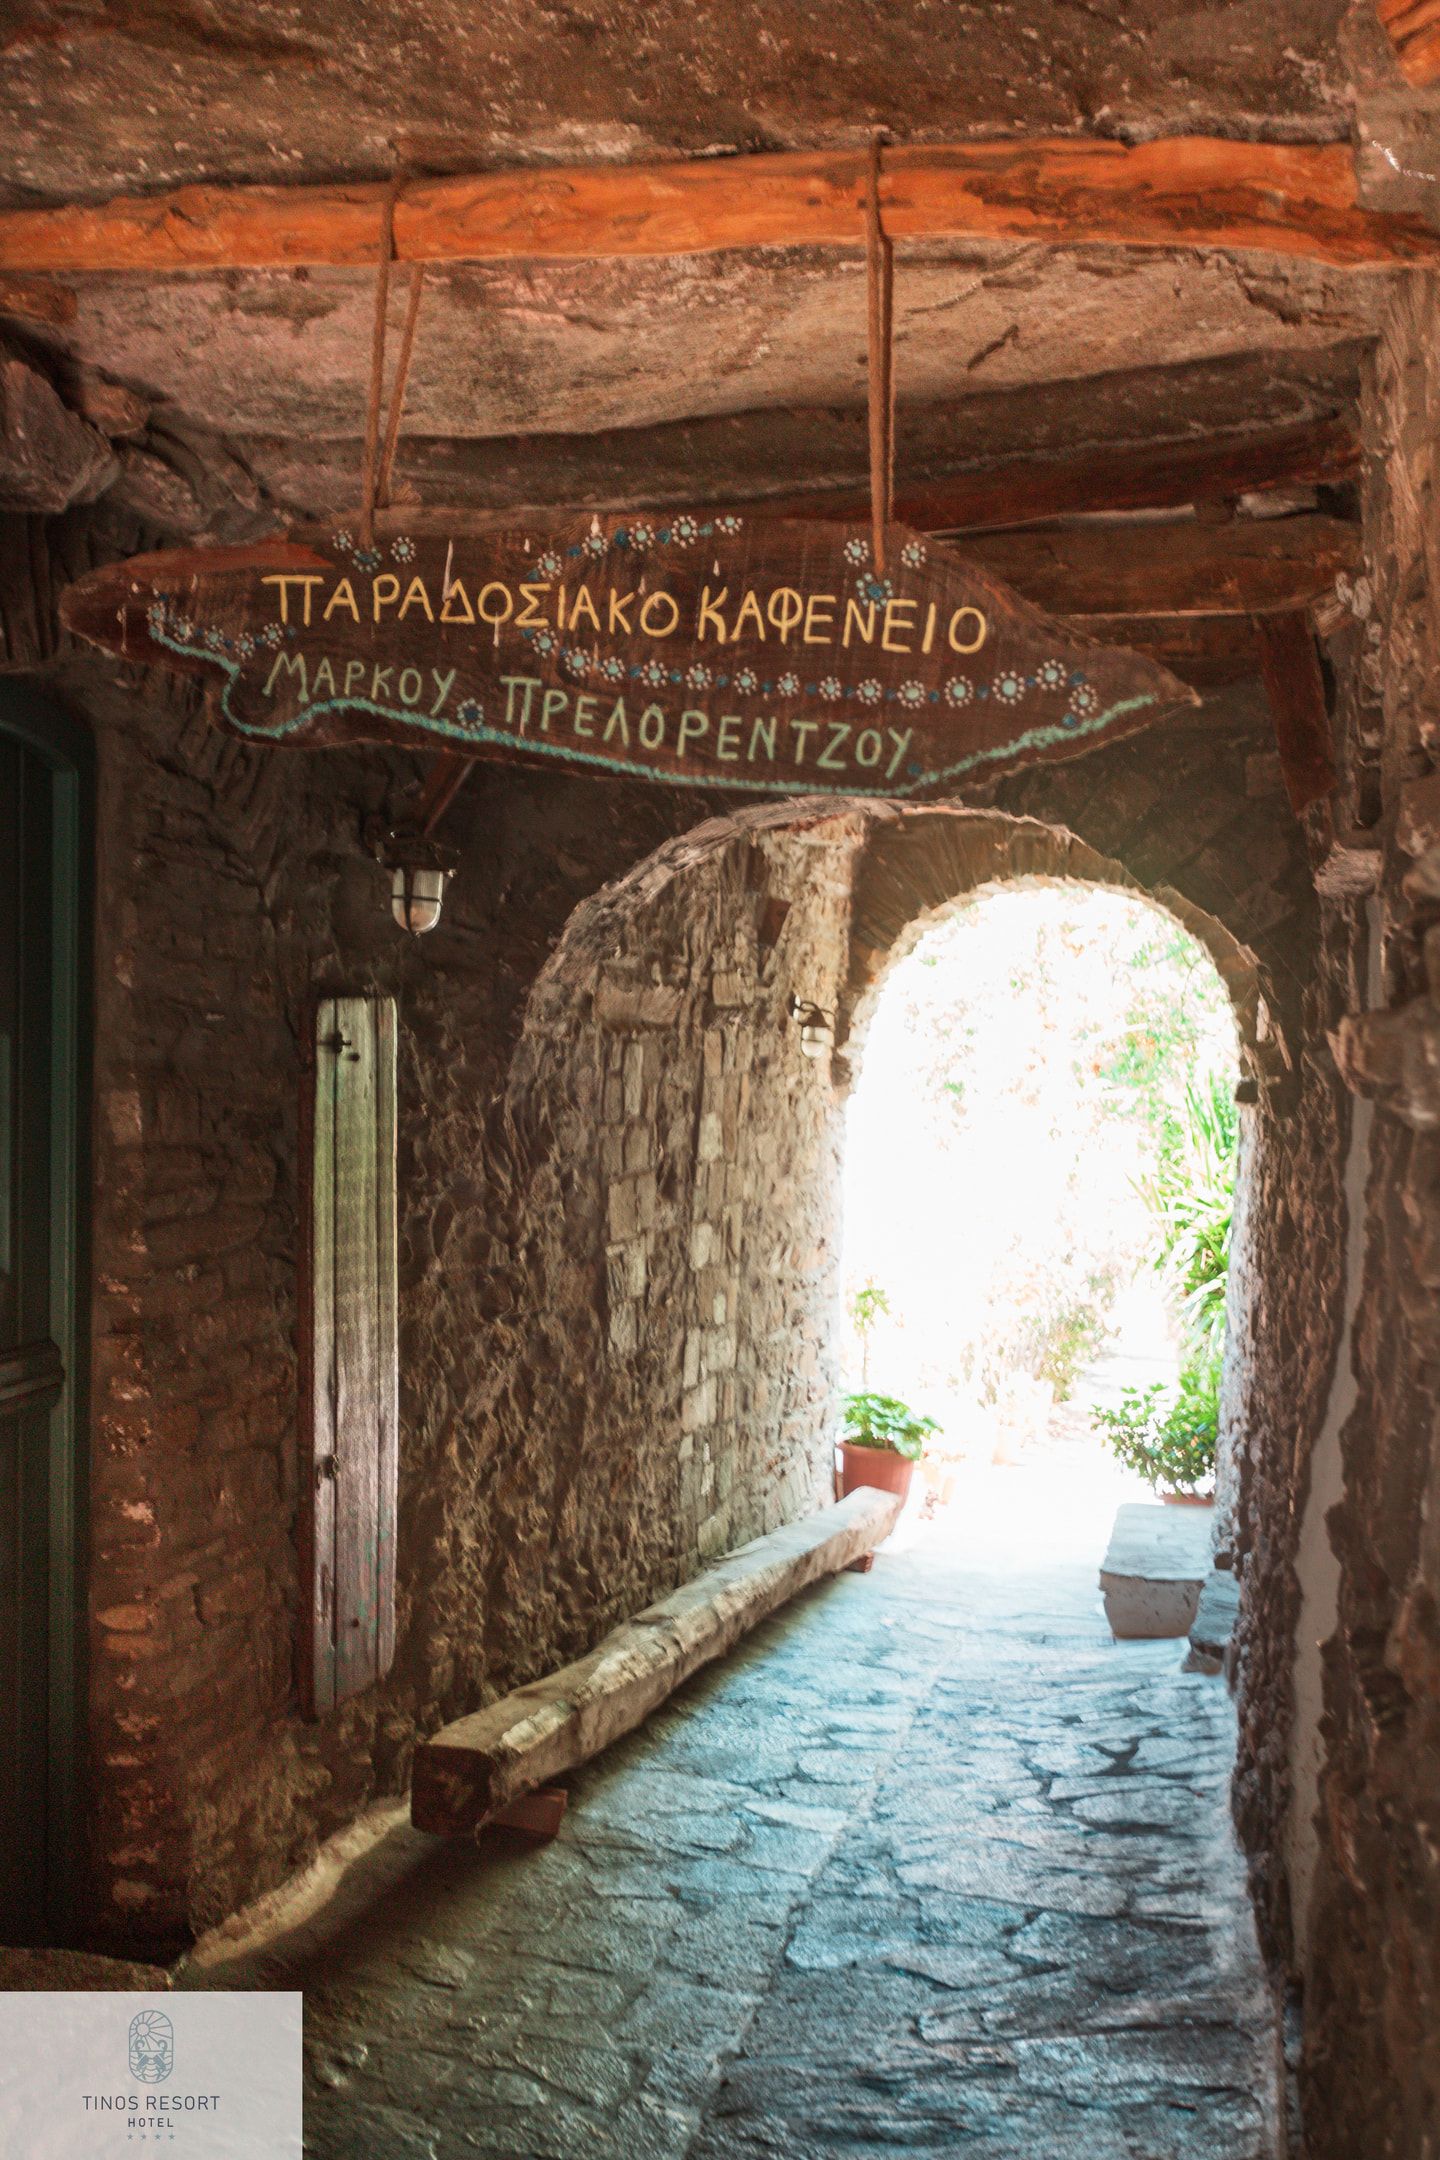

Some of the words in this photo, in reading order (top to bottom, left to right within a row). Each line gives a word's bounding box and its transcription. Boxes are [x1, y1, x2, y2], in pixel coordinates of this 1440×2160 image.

[261, 573, 680, 638] ΠΑΡΑΔΟΣΙΑΚΟ
[698, 585, 987, 655] ΚΑΦΕΝΕΙΟ
[262, 650, 457, 717] ΜΑΡΚΟΥ
[500, 674, 913, 780] ΠΡΕΛΟΡΕΝΤΖΟΥ
